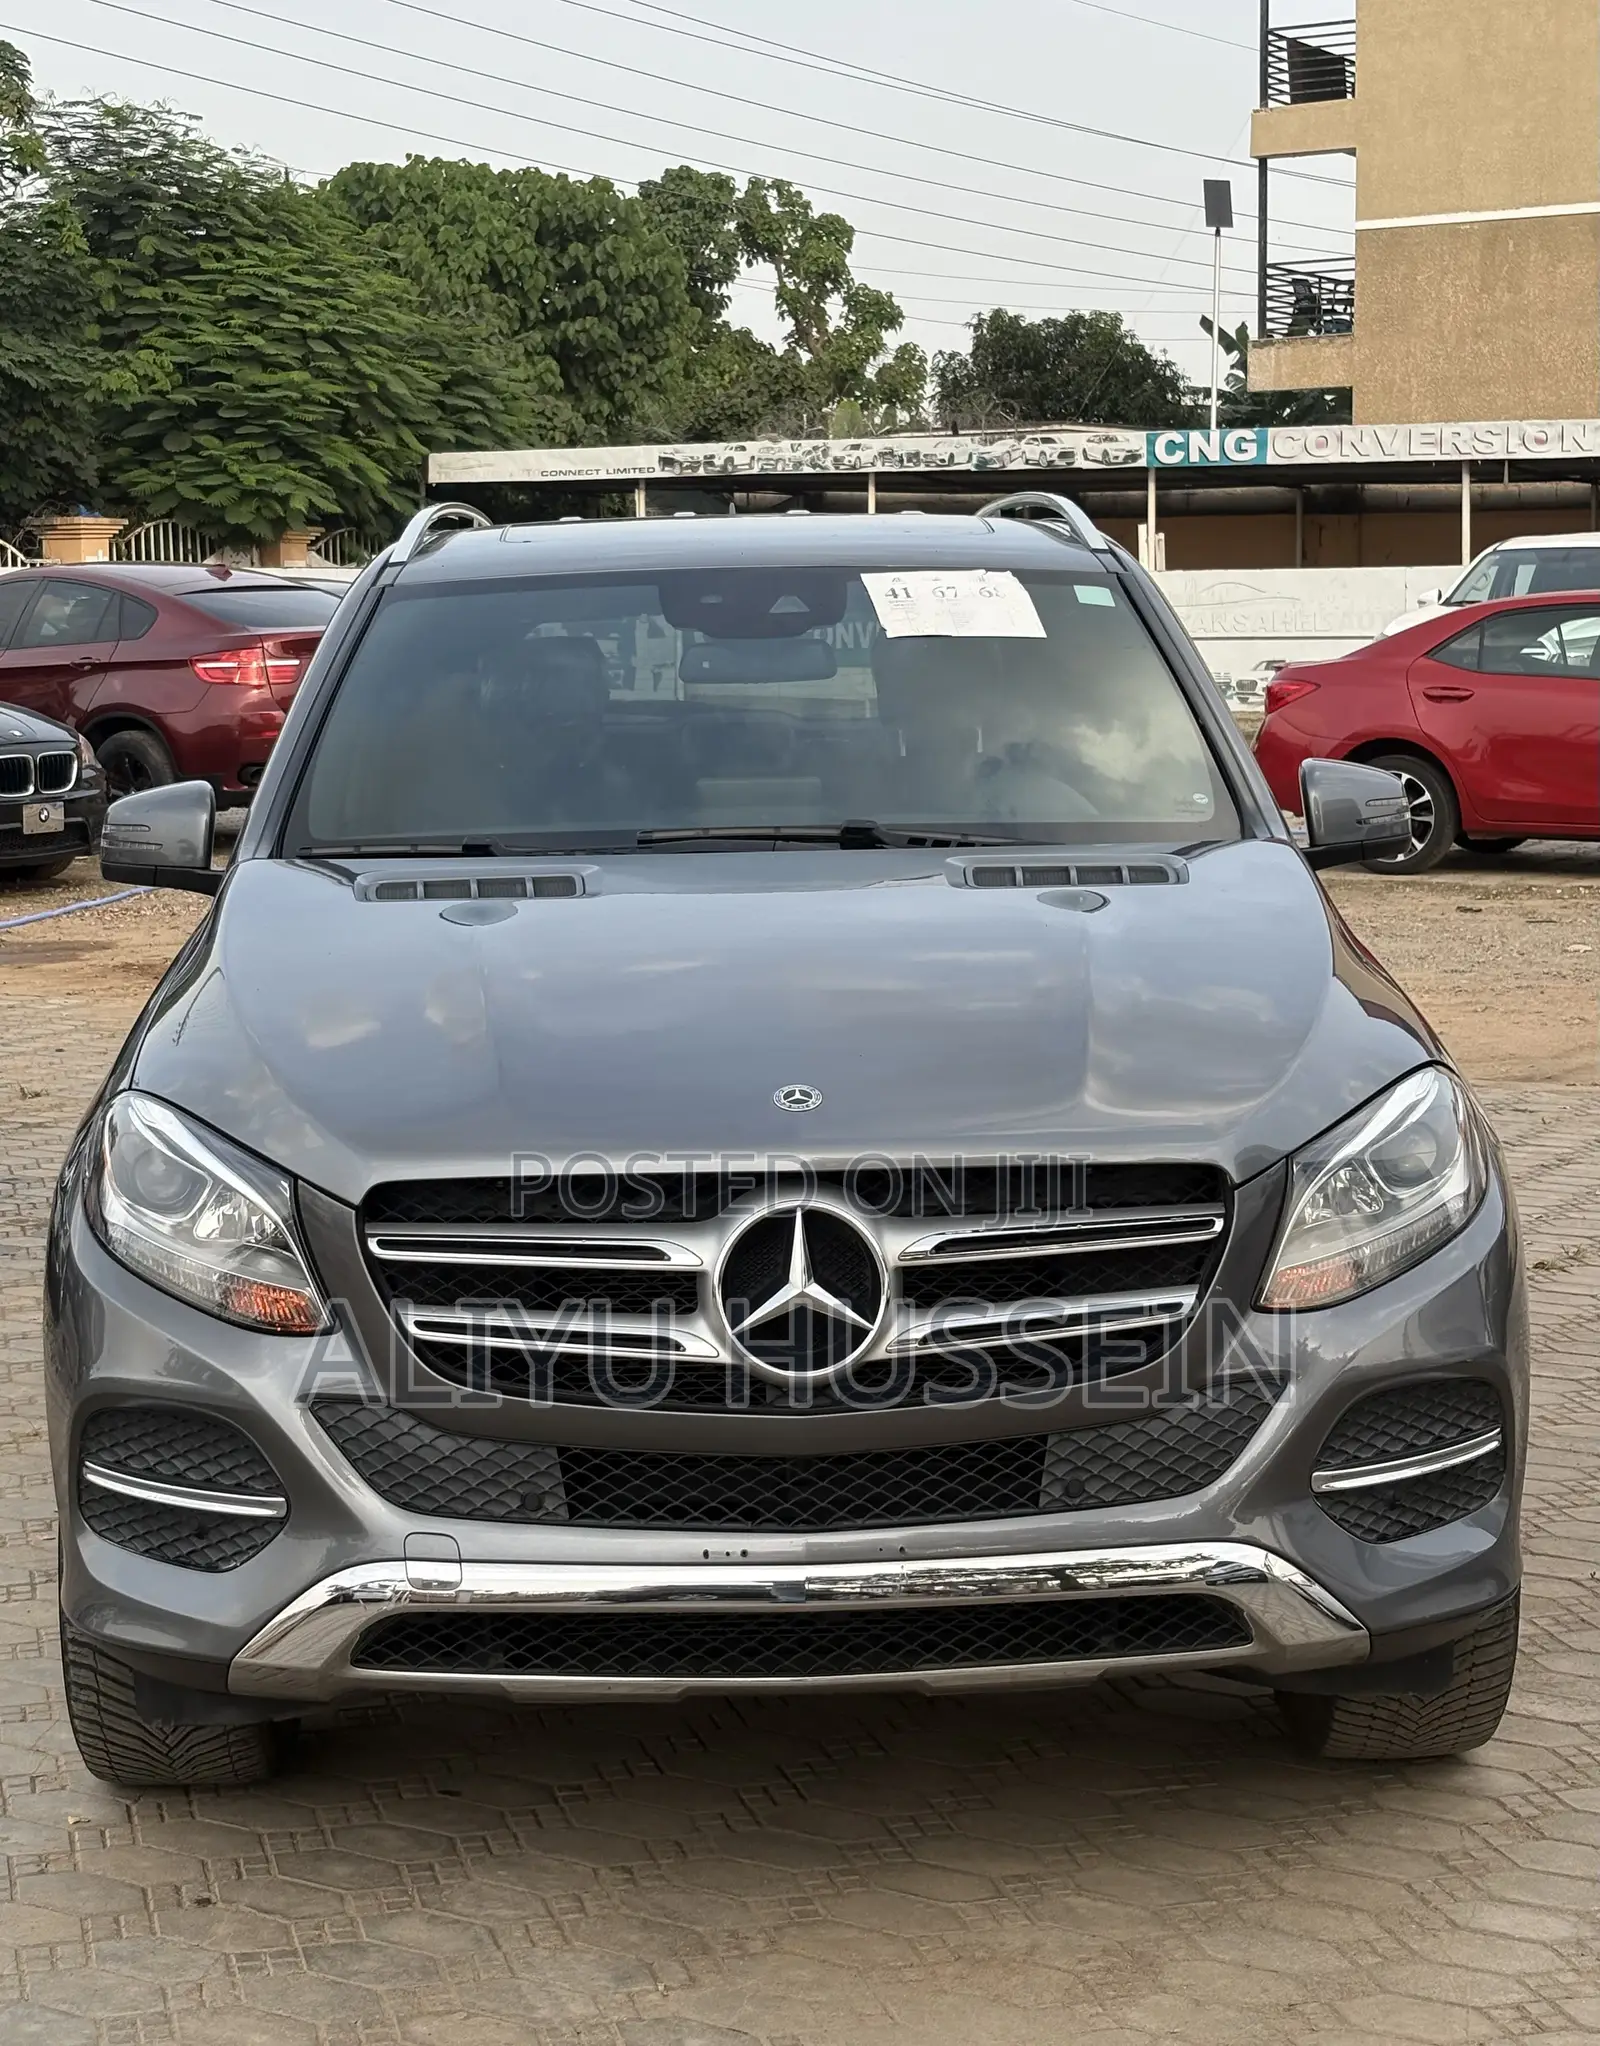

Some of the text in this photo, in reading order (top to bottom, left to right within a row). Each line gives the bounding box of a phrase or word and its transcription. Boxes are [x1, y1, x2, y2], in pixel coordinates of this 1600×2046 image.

[1154, 423, 1593, 464] CNG CONVERSION
[540, 468, 601, 477] CONNECT
[605, 466, 656, 475] LIMITED
[884, 587, 913, 599] 41
[931, 585, 958, 599] 67
